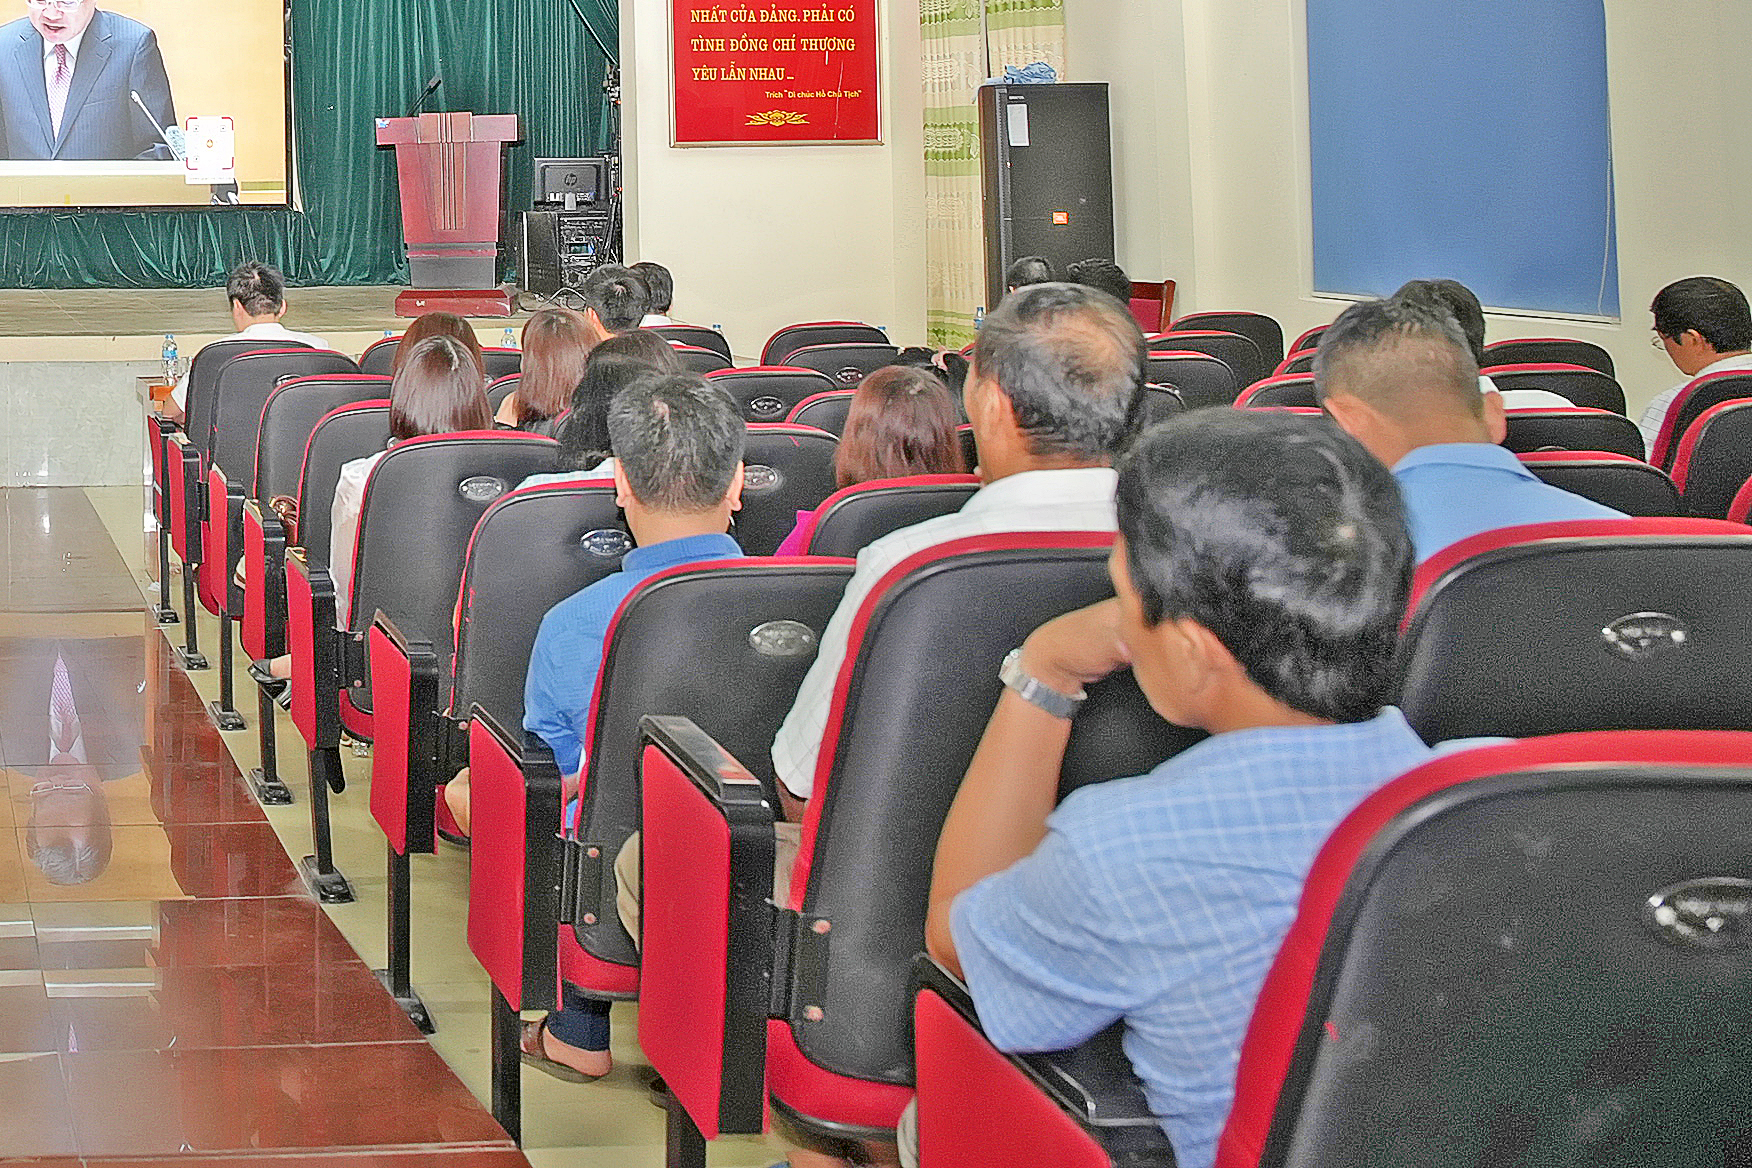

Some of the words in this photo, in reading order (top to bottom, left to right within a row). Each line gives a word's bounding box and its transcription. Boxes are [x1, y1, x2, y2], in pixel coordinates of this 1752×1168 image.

[691, 5, 727, 22] NHẤT
[730, 4, 759, 22] CỦA
[803, 3, 834, 22] PHẢI
[838, 5, 854, 21] CÓ
[691, 35, 725, 51] TÌNH
[730, 33, 768, 51] ĐỒNG
[773, 34, 796, 51] CHÍ
[801, 37, 855, 51] THƯƠNG
[692, 65, 717, 80] YÊU
[720, 61, 746, 80] LẪN
